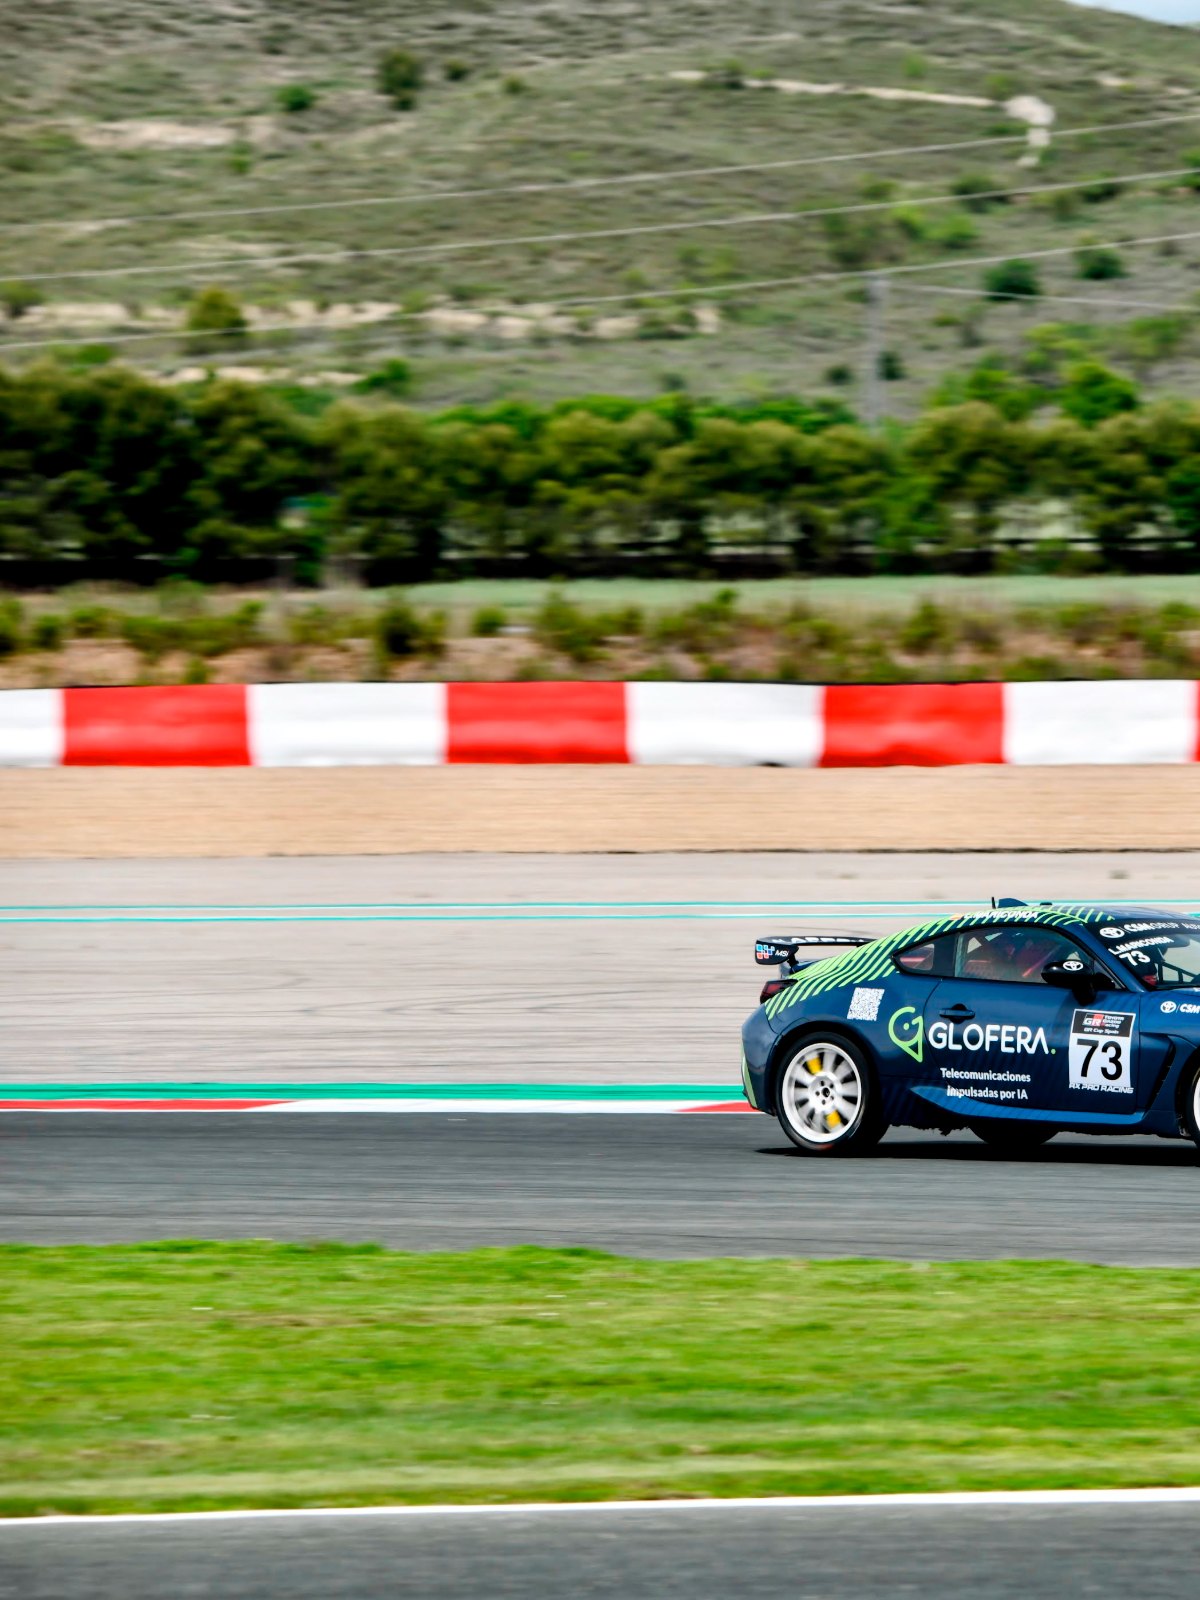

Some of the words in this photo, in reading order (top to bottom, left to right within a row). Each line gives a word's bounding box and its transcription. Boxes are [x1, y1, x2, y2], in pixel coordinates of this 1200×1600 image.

[1119, 950, 1151, 966] 73
[1077, 1038, 1122, 1081] 73
[940, 1067, 1031, 1082] Telecomunicaciones
[1000, 1088, 1016, 1100] por
[1017, 1088, 1028, 1099] IA
[1101, 1085, 1134, 1094] RACING
